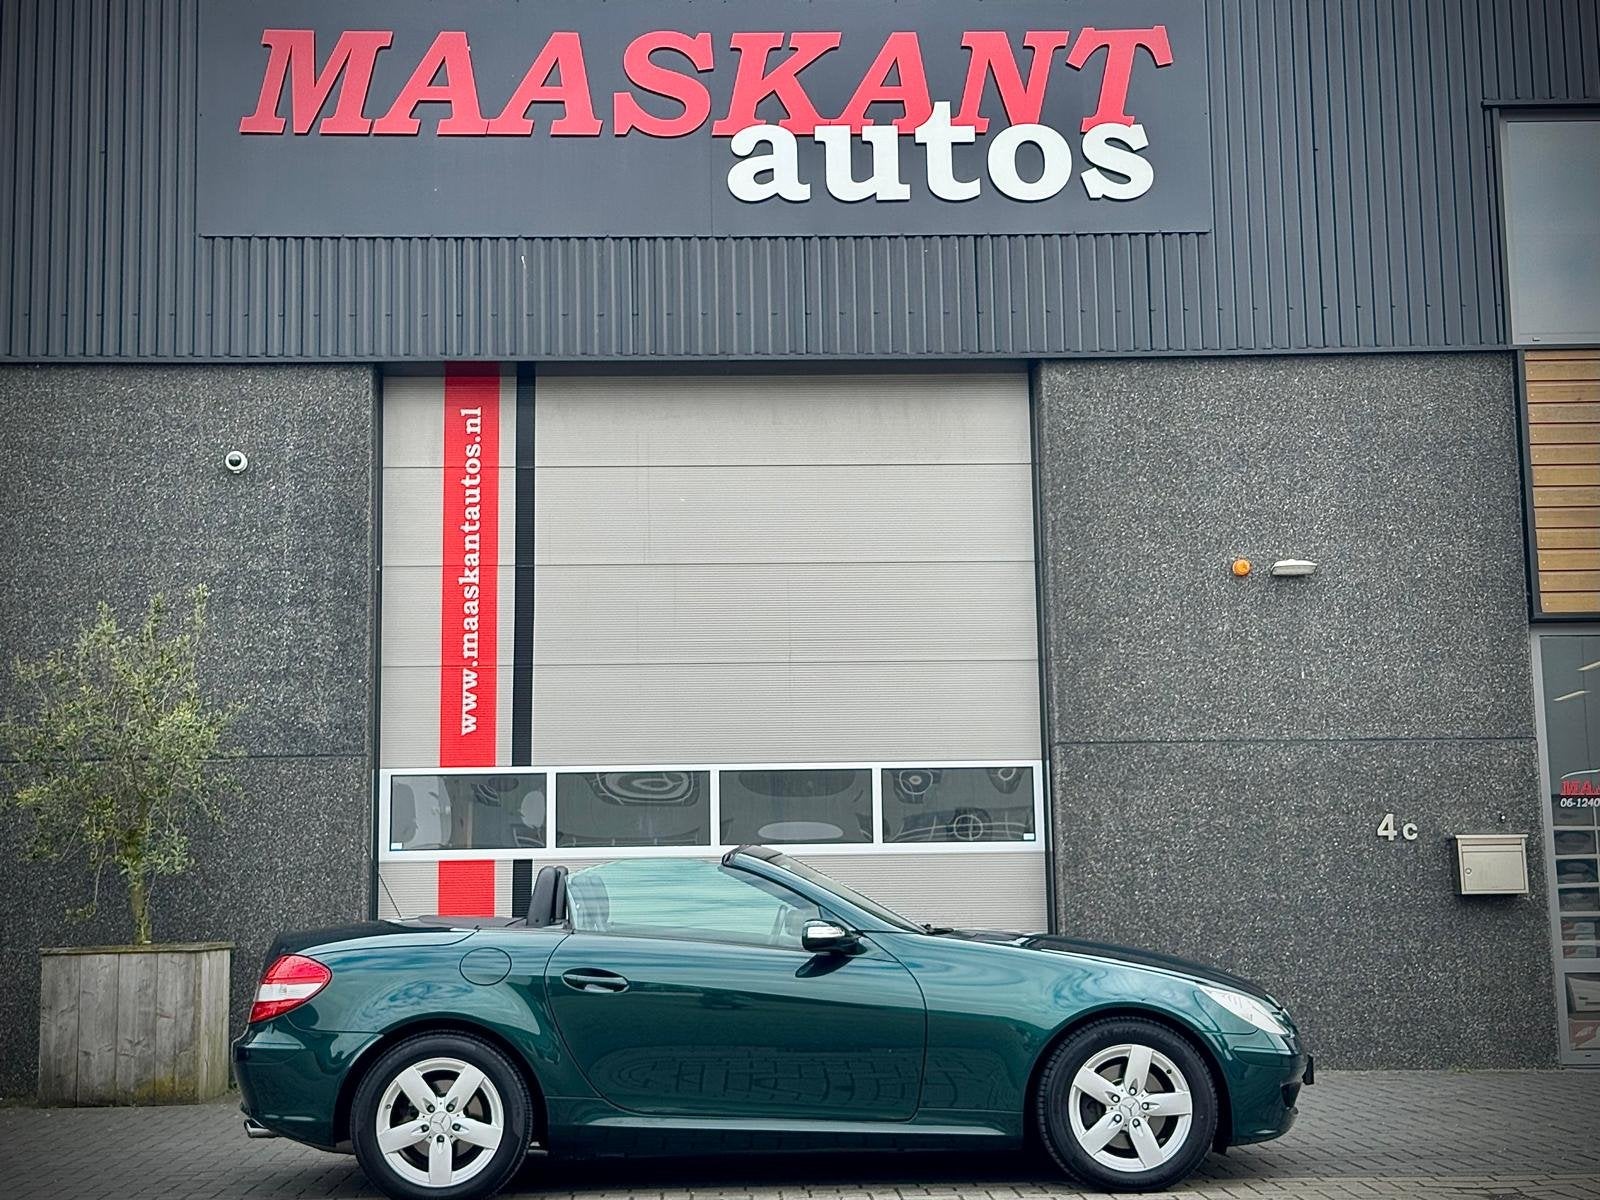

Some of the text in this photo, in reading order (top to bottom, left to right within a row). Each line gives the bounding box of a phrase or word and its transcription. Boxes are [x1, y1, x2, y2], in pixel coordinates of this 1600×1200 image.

[239, 26, 1174, 136] MAASKANT
[727, 101, 1155, 202] autos
[459, 406, 483, 736] www.maaskantautos.nl
[1560, 780, 1600, 796] MA
